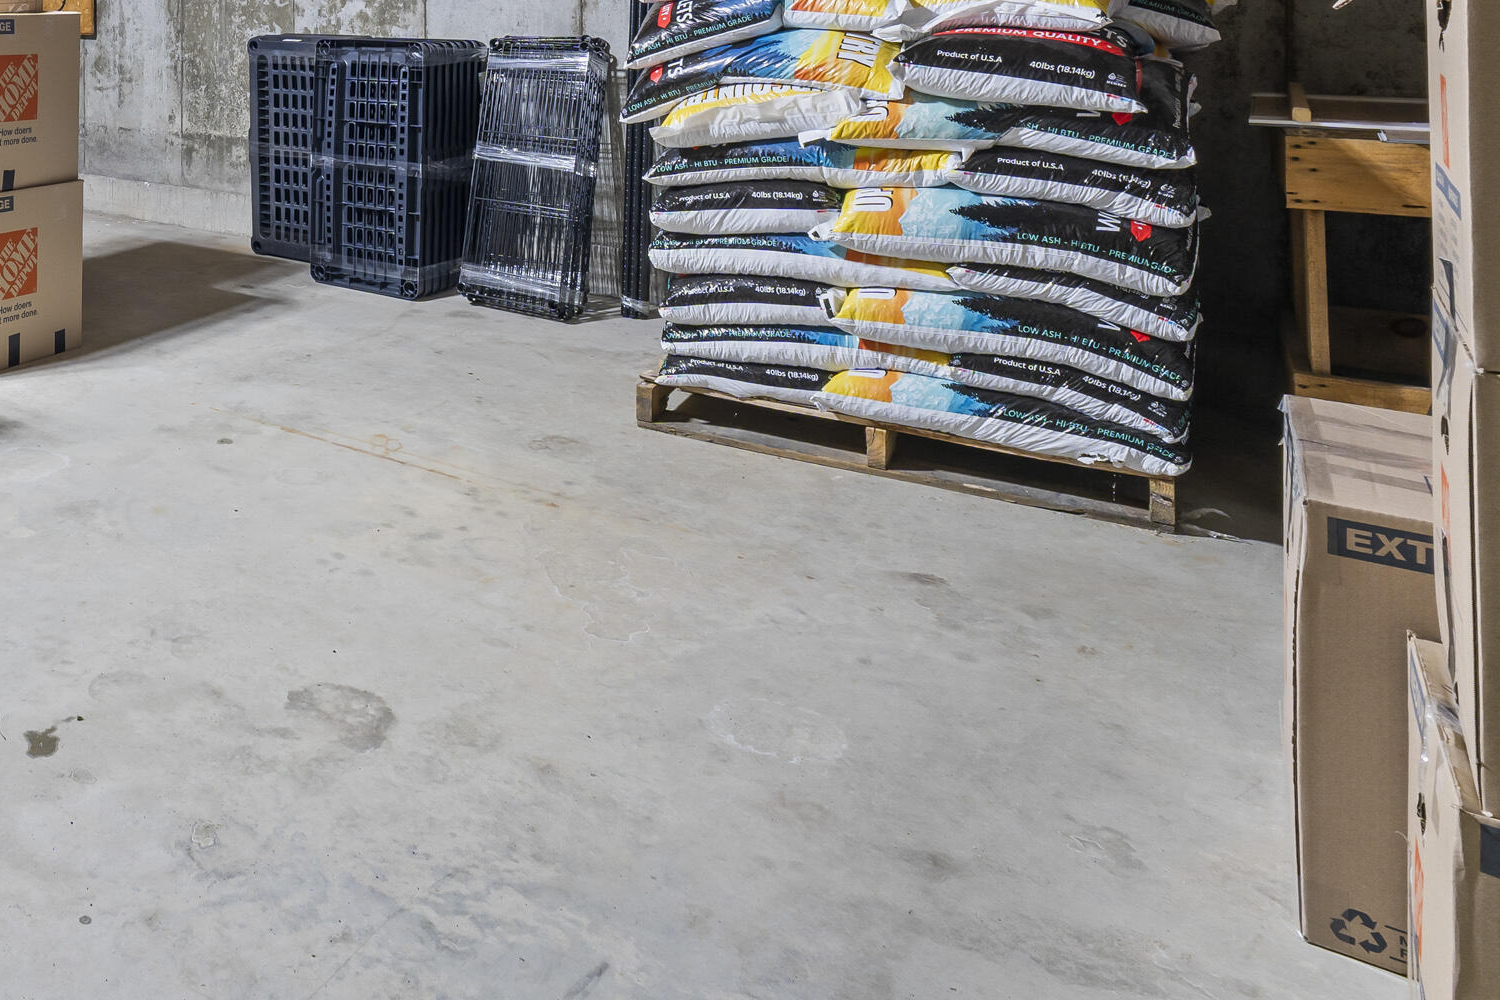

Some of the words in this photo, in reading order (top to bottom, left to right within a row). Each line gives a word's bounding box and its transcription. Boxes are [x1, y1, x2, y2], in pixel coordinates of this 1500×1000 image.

[647, 41, 661, 52] ASH
[666, 36, 674, 45] HI
[674, 32, 688, 42] BTU
[694, 22, 726, 38] PREMIUM
[727, 14, 752, 28] GRADE
[1032, 31, 1102, 48] QUALITY
[937, 50, 968, 60] Product
[970, 52, 979, 60] of
[1030, 61, 1054, 70] 40lbs
[1057, 64, 1096, 79] (18.14kg)
[11, 79, 38, 121] DEPOT
[628, 102, 641, 112] LOW
[643, 97, 656, 107] ASH
[661, 92, 668, 101] HI
[668, 89, 681, 99] BTU
[686, 79, 717, 95] PREMIUM
[14, 127, 32, 135] doers
[3, 137, 20, 146] more
[1088, 134, 1135, 151] PREMIUM
[724, 157, 759, 165] PREMIUM
[761, 155, 787, 163] GRADE
[997, 157, 1029, 167] Product
[1031, 159, 1040, 167] of
[751, 191, 772, 199] 40lbs
[773, 191, 803, 200] (18.14kg)
[751, 239, 778, 247] GRADE
[1017, 232, 1040, 242] LOW
[1041, 234, 1061, 245] ASH
[10, 253, 38, 297] DEPOT
[776, 285, 806, 297] (18.14kg)
[14, 301, 32, 312] doers
[3, 313, 20, 324] more
[765, 329, 791, 338] GRADE
[1018, 325, 1040, 335] LOW
[1042, 328, 1061, 339] ASH
[717, 362, 724, 370] of
[994, 356, 1026, 370] Product
[1028, 361, 1037, 371] of
[765, 368, 786, 378] 40lbs
[1082, 374, 1107, 389] 40lbs
[1003, 407, 1027, 419] LOW
[1097, 427, 1145, 447] PREMIUM
[1345, 527, 1434, 565] EXT
